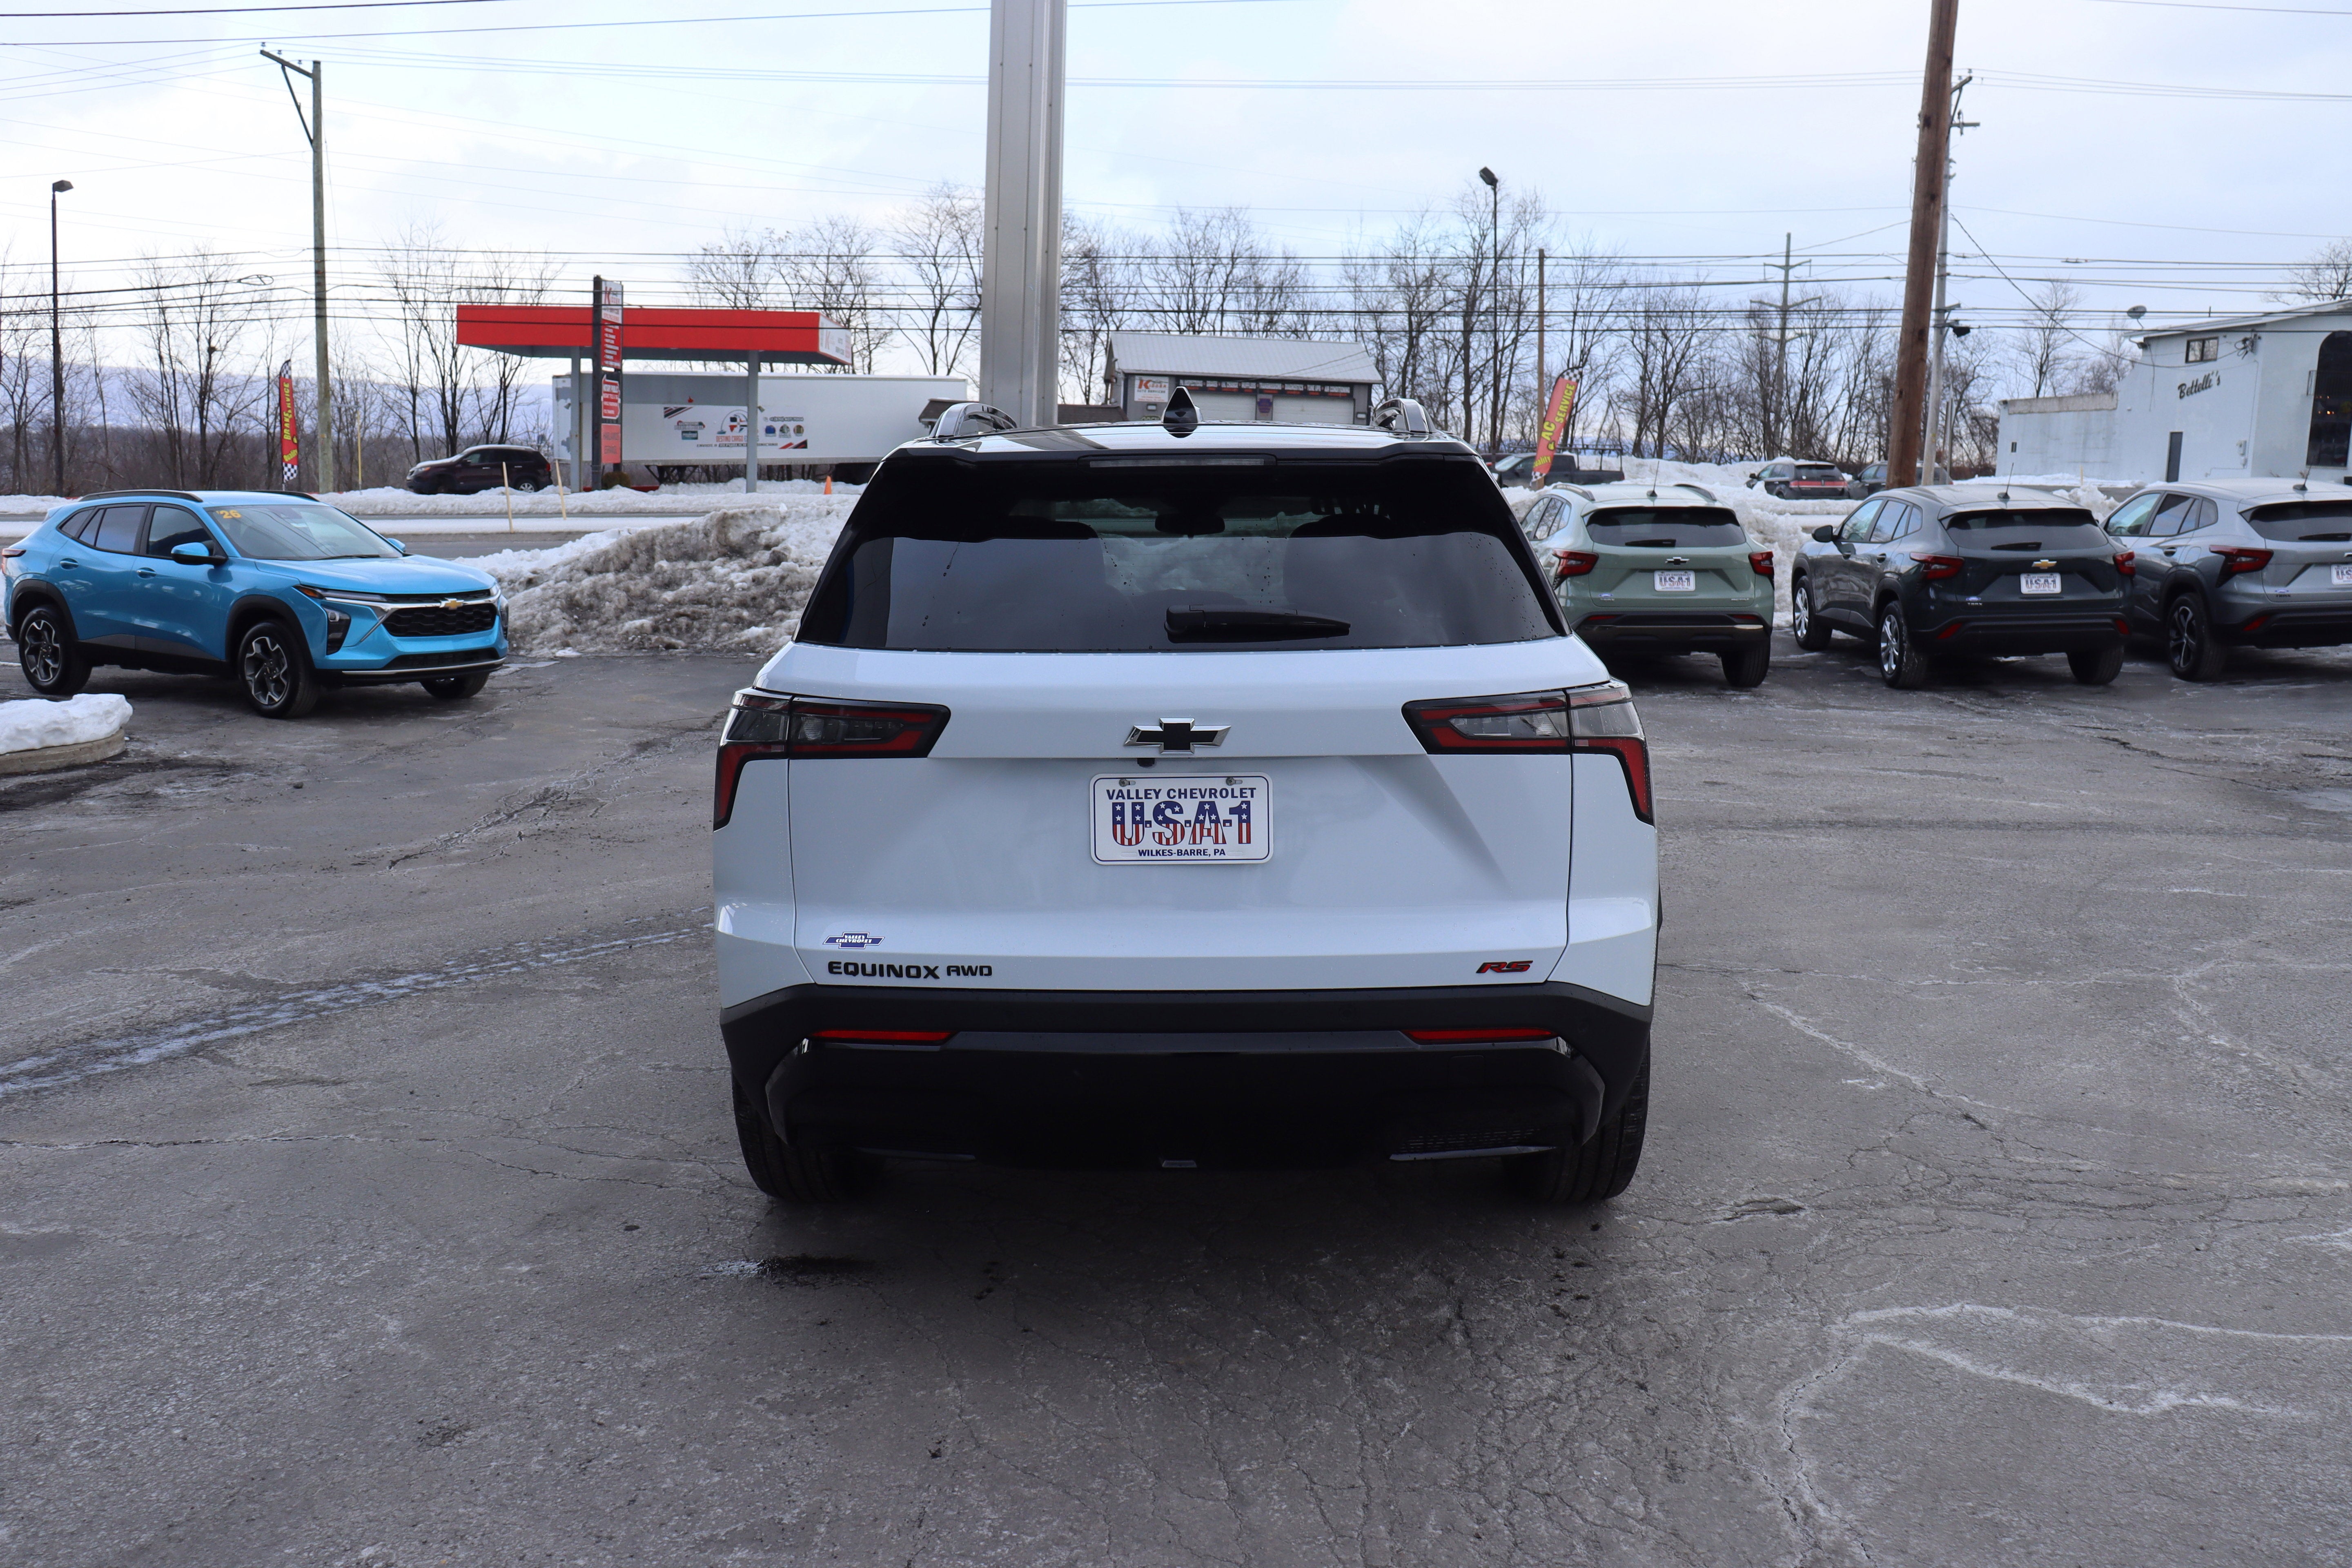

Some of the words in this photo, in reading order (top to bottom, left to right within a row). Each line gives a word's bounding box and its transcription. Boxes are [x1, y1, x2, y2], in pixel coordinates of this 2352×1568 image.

[1555, 383, 1575, 423] SERVICE
[1541, 421, 1556, 441] AC
[1533, 455, 1551, 468] uality
[216, 510, 241, 519] '26
[1106, 788, 1162, 800] VALLEY
[1167, 788, 1256, 799] CHEVROLET
[1138, 849, 1211, 857] WILKES-BARRE,
[828, 961, 940, 979] EQUINOX
[947, 965, 992, 976] AWD
[1476, 960, 1533, 973] RS
